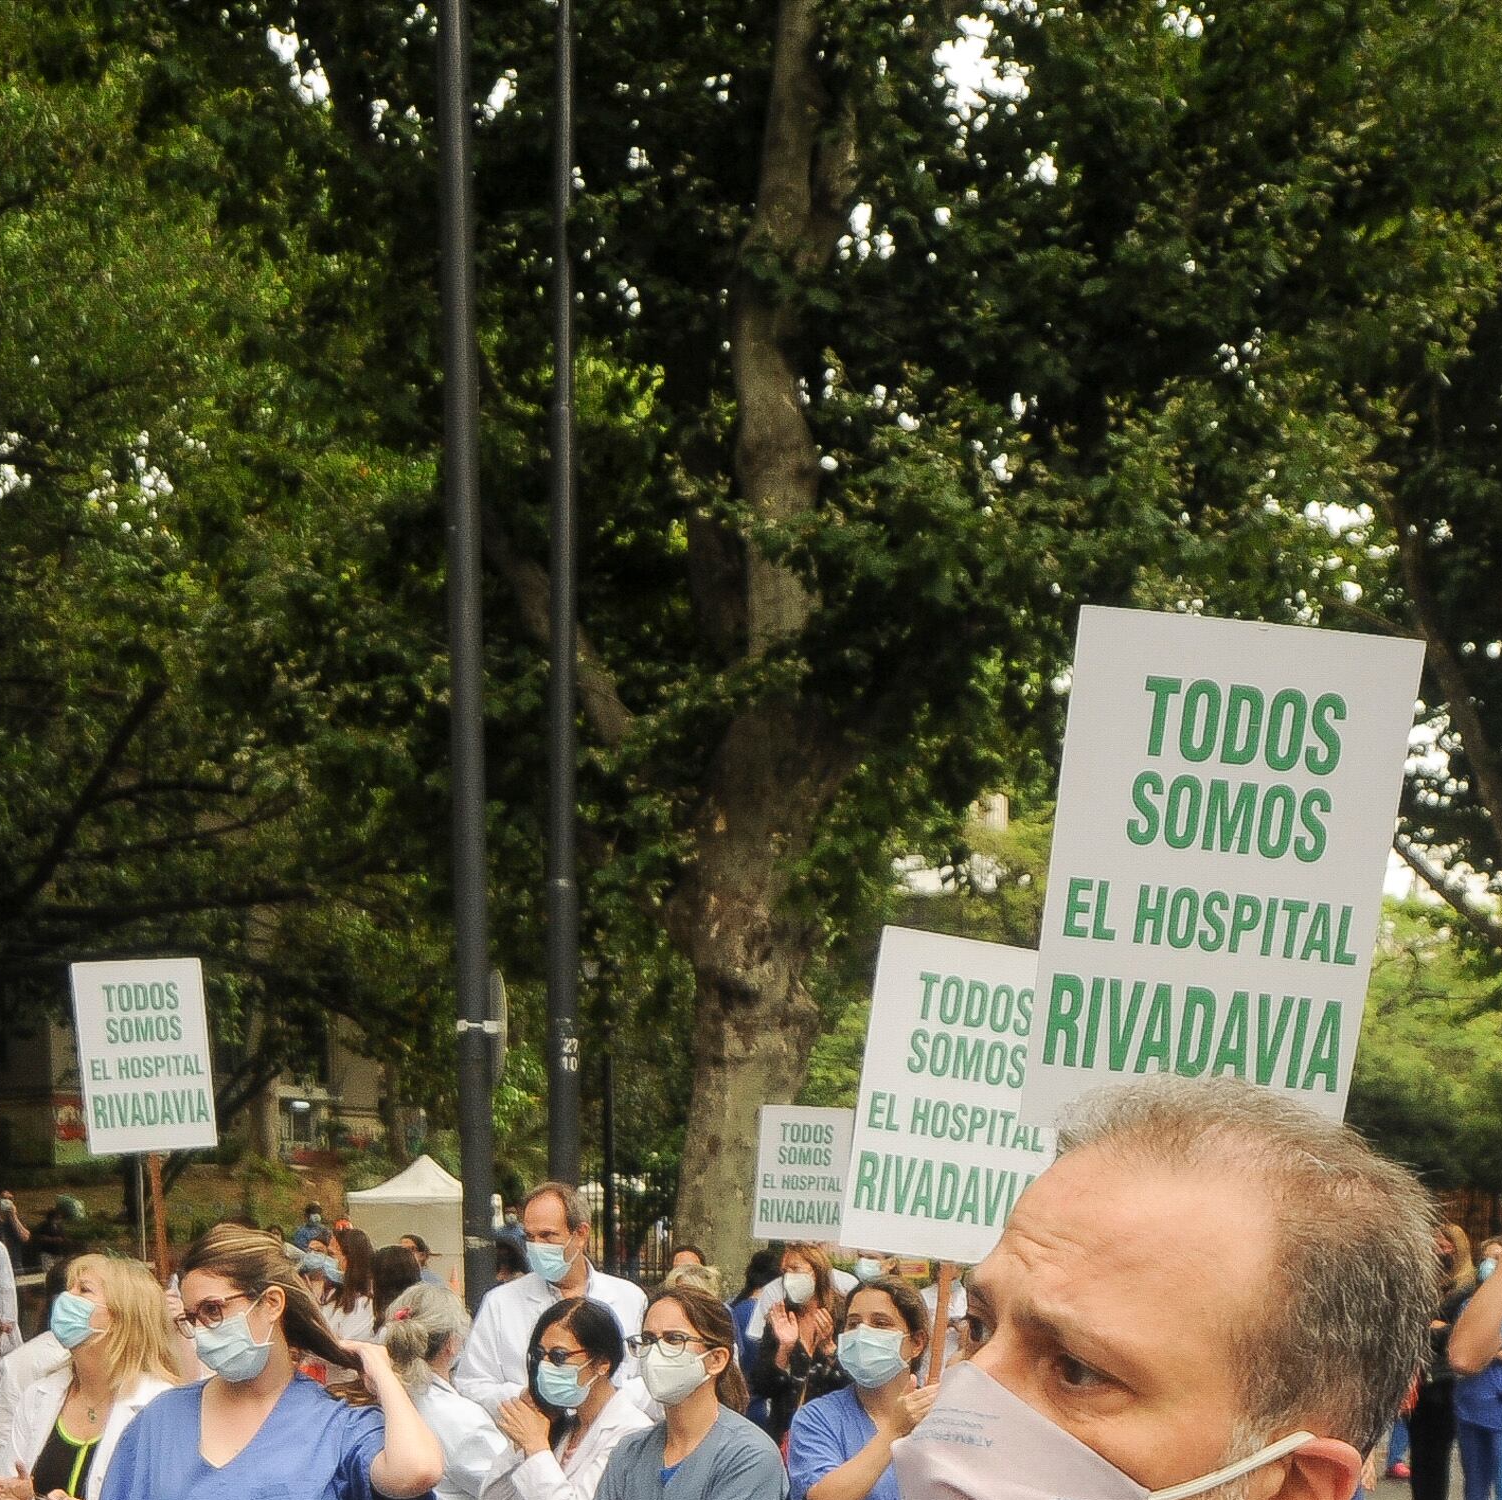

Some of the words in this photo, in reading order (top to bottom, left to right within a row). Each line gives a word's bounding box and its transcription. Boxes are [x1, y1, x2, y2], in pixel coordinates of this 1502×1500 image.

[1146, 676, 1347, 776] TODOS
[1126, 770, 1333, 862] SOMOS
[1063, 877, 1115, 941] EL
[1133, 885, 1357, 965] HOSPITAL
[102, 981, 179, 1012] TODOS
[920, 971, 1035, 1037] TODOS
[106, 1015, 182, 1044] SOMOS
[1042, 973, 1342, 1093] RIVADAVIA
[90, 1058, 112, 1081] EL
[117, 1054, 204, 1080] HOSPITAL
[907, 1029, 1027, 1089] SOMOS
[92, 1088, 210, 1129] RIVADAVIA
[780, 1122, 834, 1145] TODOS
[868, 1091, 899, 1132] EL
[910, 1096, 1045, 1153] HOSPITAL
[778, 1146, 832, 1167] SOMOS
[762, 1173, 776, 1189] EL
[781, 1174, 842, 1193] HOSPITAL
[853, 1150, 1037, 1226] RIVADAVI
[759, 1199, 841, 1225] RIVADAVIA
